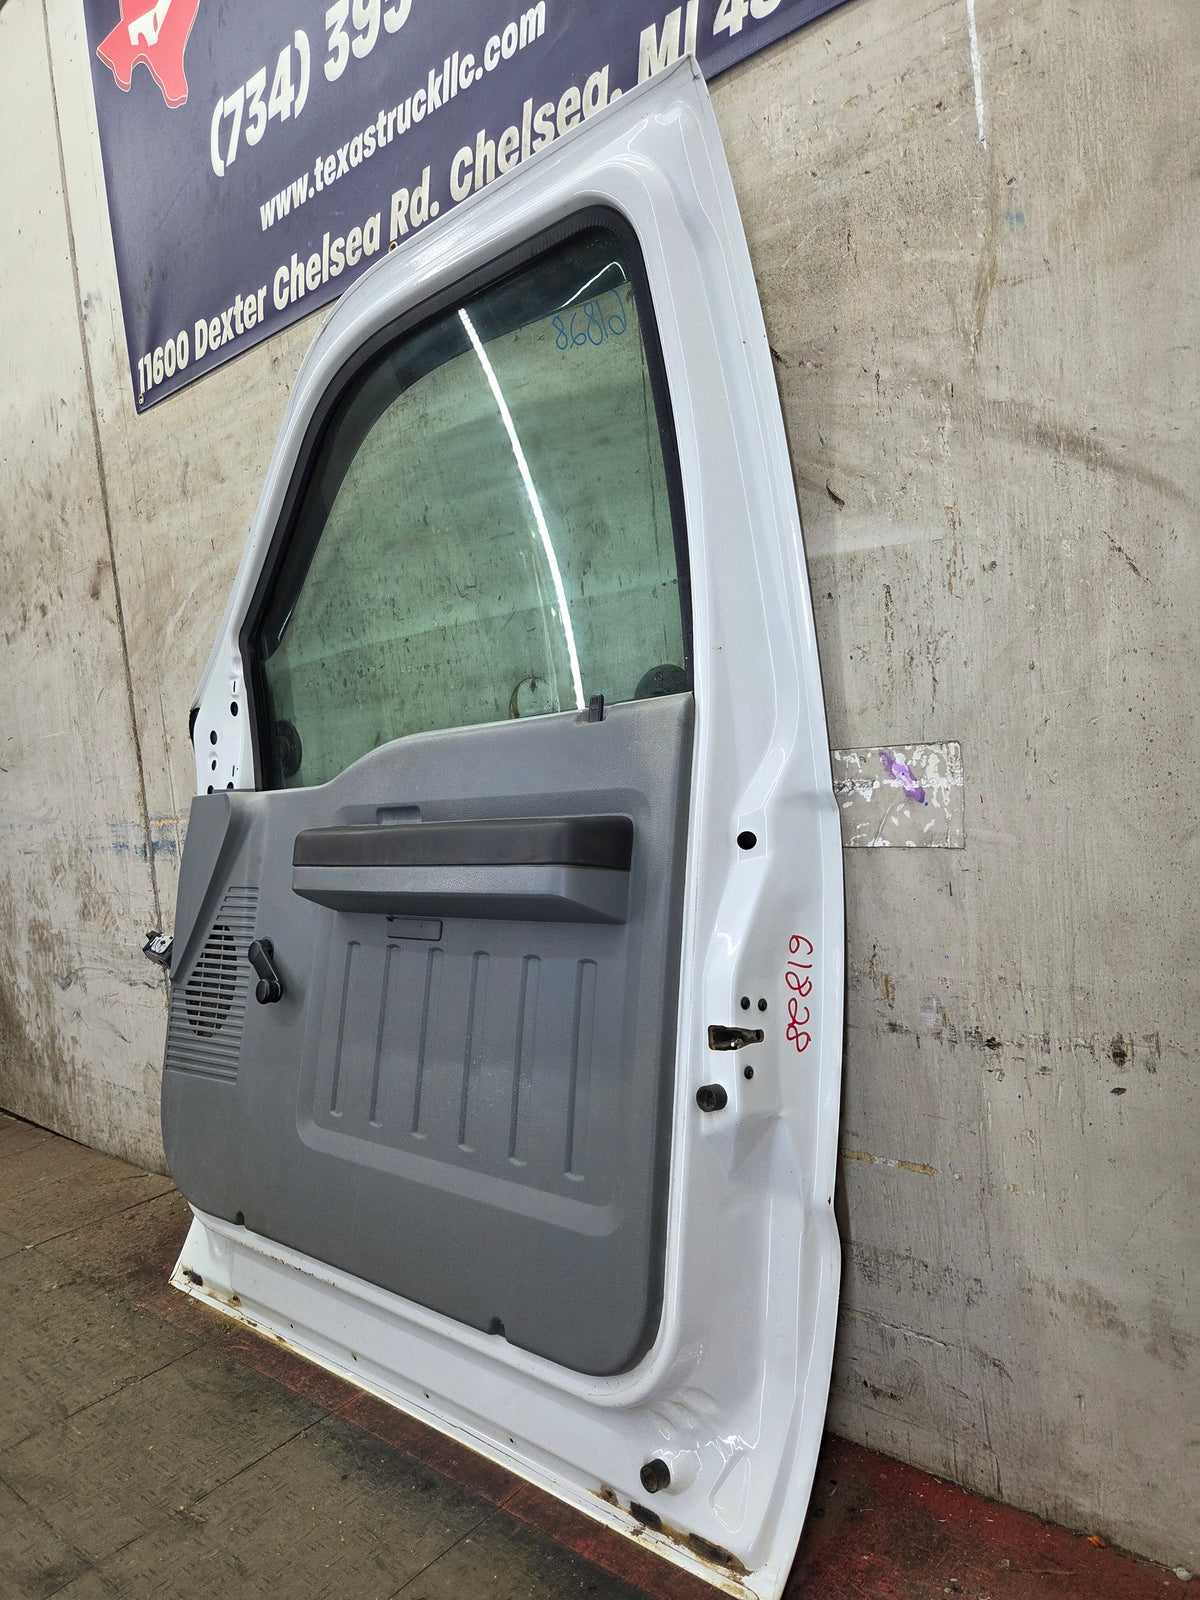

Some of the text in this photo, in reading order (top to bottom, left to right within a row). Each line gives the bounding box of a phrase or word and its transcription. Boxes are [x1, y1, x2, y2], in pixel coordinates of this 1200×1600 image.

[137, 330, 190, 395] 11600
[194, 284, 268, 361] Dexter
[272, 212, 381, 312] Chelsea
[389, 165, 440, 243] Rd.
[638, 0, 699, 84] MI
[210, 29, 311, 178] (734)
[259, 0, 546, 231] www.texastruckllc.com
